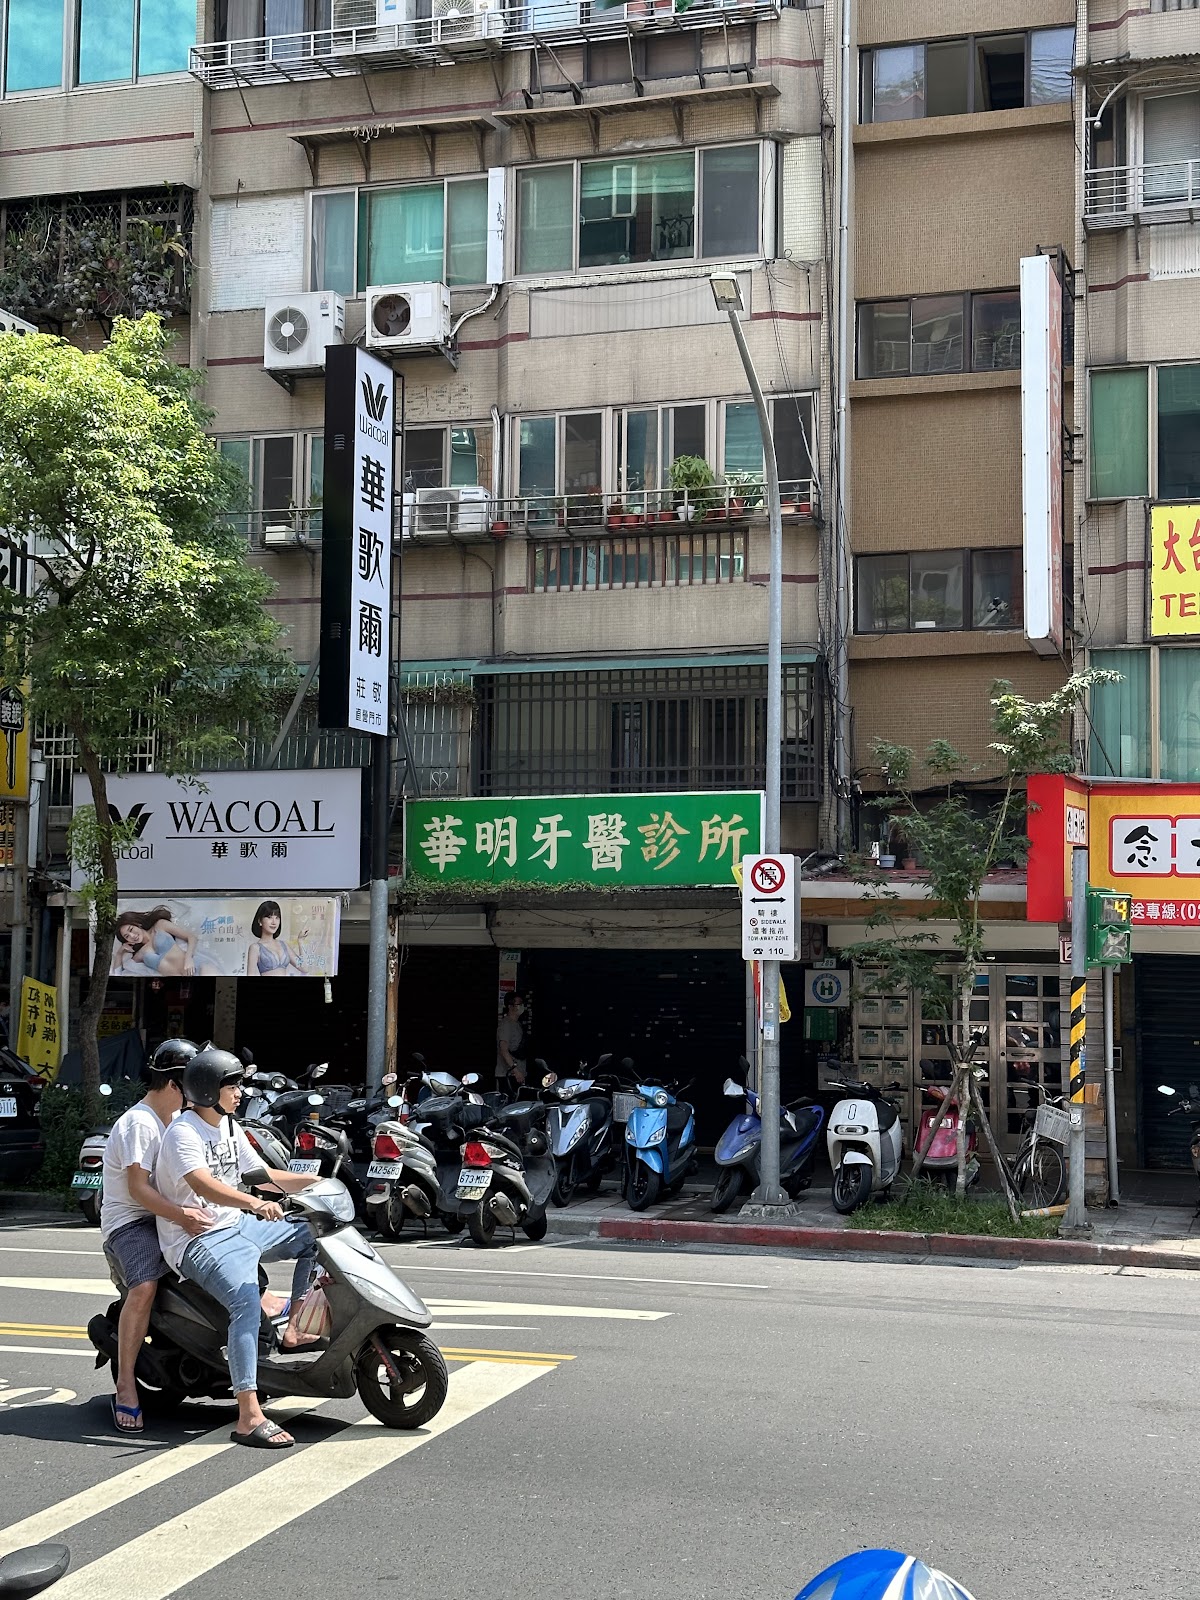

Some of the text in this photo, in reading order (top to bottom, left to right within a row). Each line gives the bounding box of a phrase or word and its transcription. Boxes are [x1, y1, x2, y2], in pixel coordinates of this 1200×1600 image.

[359, 413, 389, 447] Wacoal
[358, 454, 386, 657] 華歌爾
[1160, 593, 1200, 618] TE
[356, 676, 382, 704] 莊敬
[166, 800, 335, 834] WACOAL
[97, 843, 154, 860] acoal
[211, 841, 288, 858] 華歌爾
[419, 810, 749, 874] 華明牙醫診所
[1123, 825, 1200, 868] 念
[768, 947, 784, 955] 110
